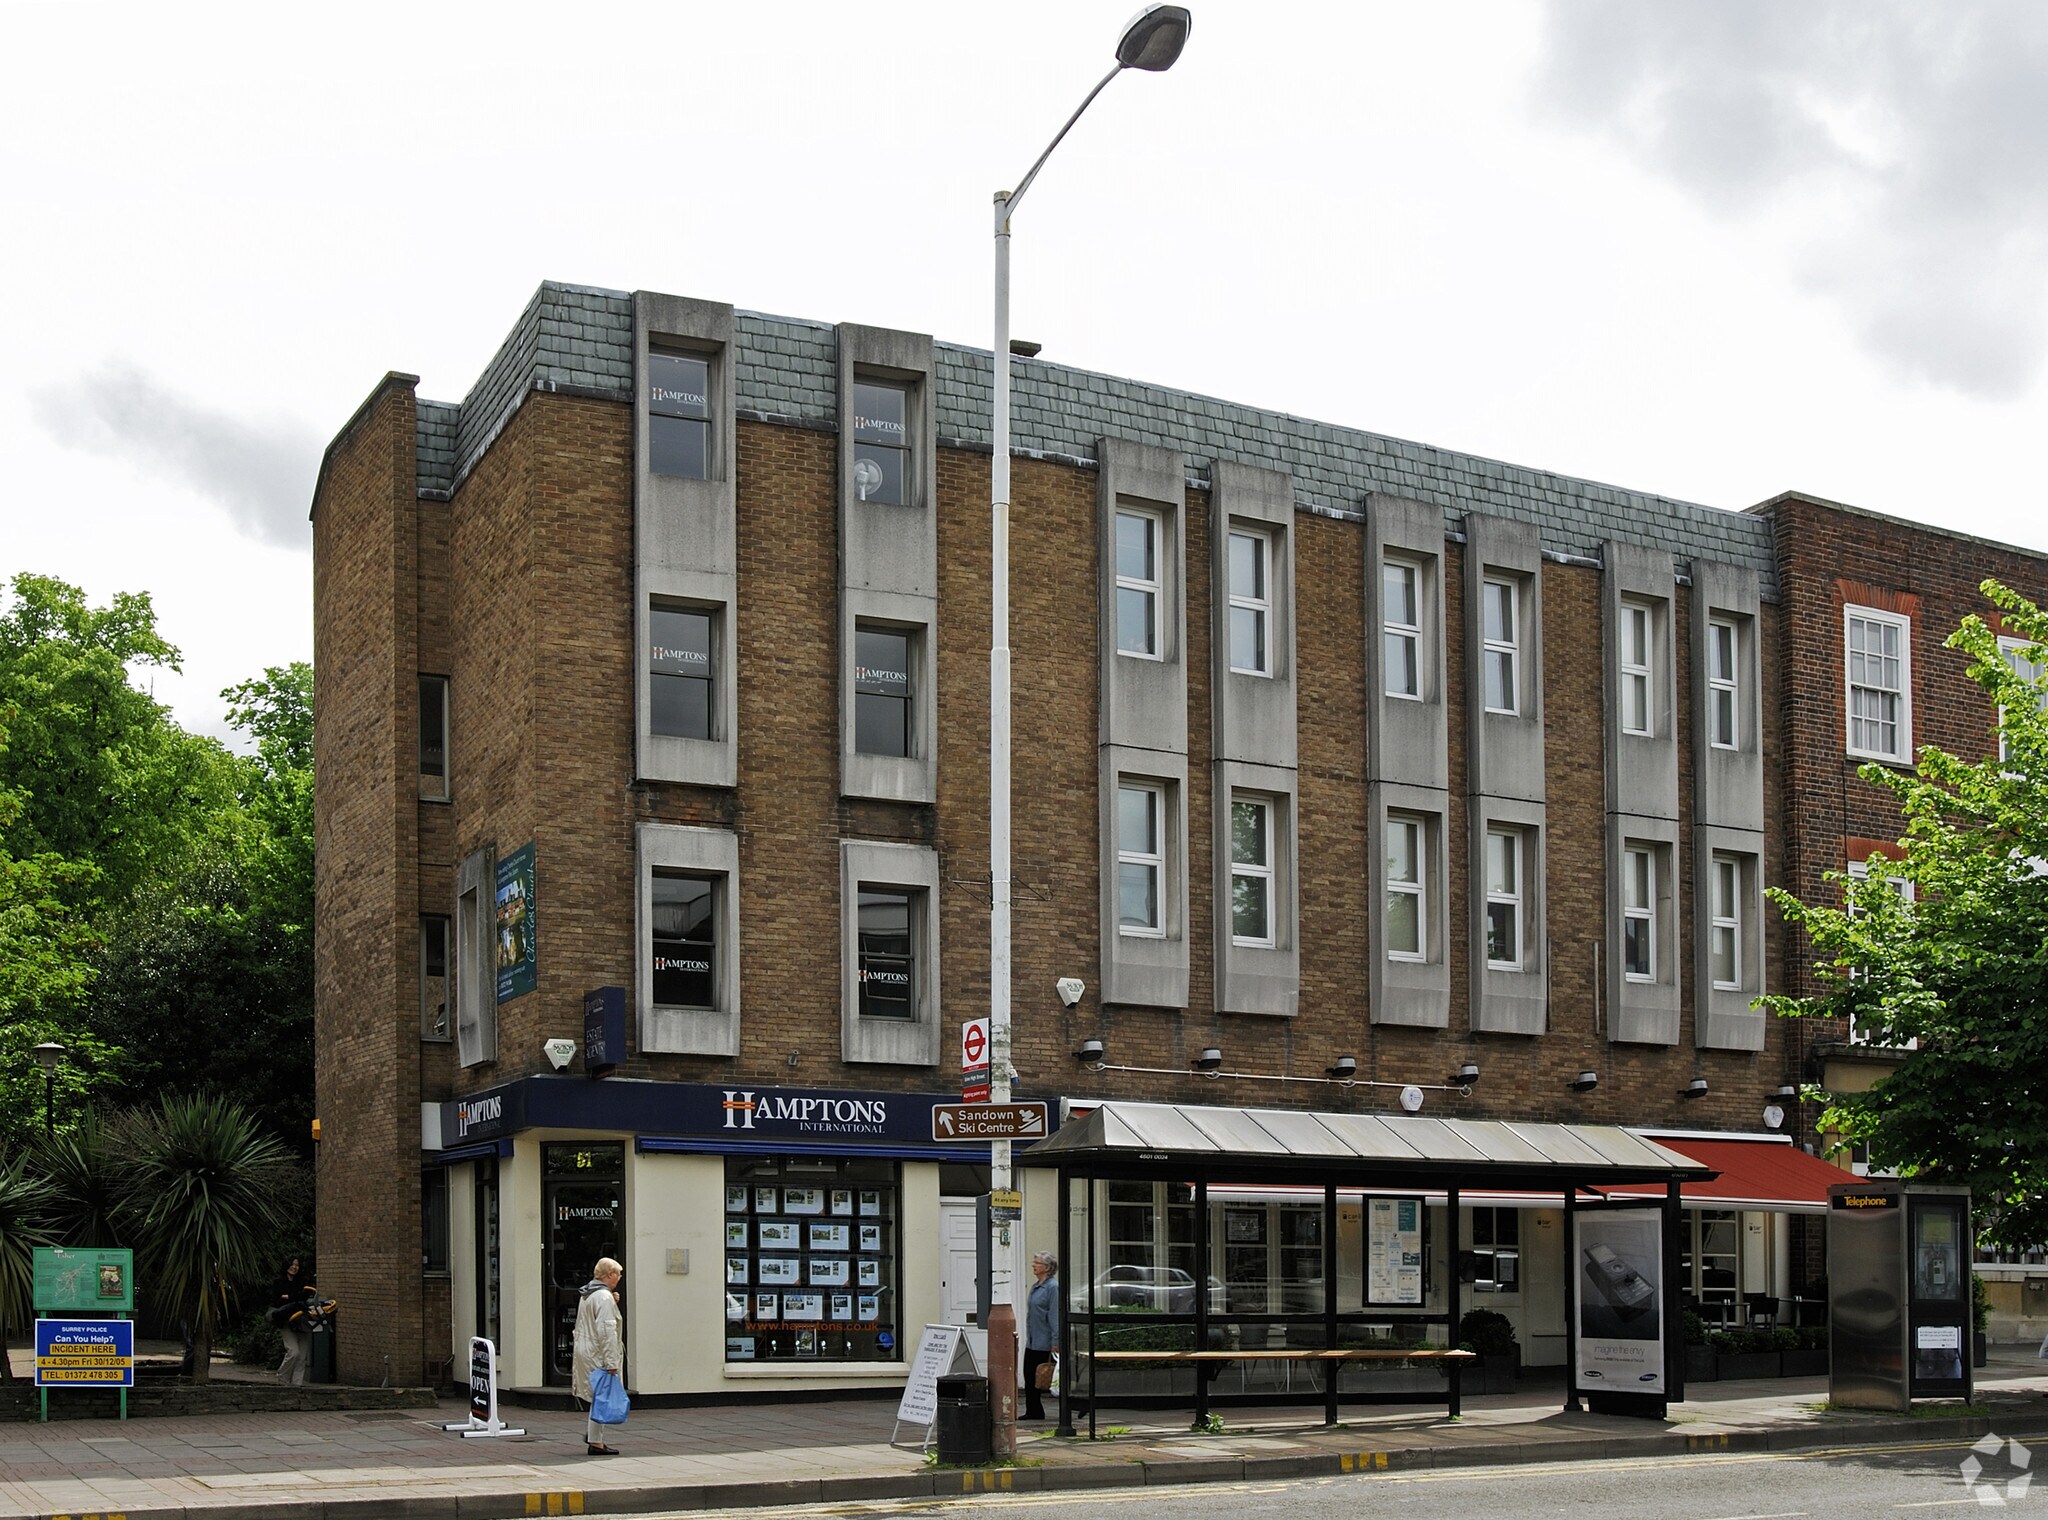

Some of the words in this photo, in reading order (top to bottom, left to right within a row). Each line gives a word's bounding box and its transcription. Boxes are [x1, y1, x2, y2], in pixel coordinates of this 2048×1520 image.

[652, 387, 706, 404] HAMPTONS
[855, 416, 906, 431] HAMPTONS
[653, 646, 707, 661] HAMPTONS
[856, 667, 907, 681] HAMPTONS
[655, 957, 709, 971] HAMPTONS
[858, 969, 909, 982] HAMPTONS
[458, 1095, 502, 1137] HAMPTONS
[722, 1091, 887, 1129] HAMPTONS
[959, 1110, 1014, 1120] Sandown
[800, 1122, 885, 1133] INTERNATIONAL
[959, 1123, 975, 1133] Ski
[978, 1122, 1014, 1133] Centre
[576, 1151, 592, 1168] 51
[1844, 1196, 1887, 1208] Telephone
[558, 1206, 614, 1221] HAMPTONS
[745, 1321, 879, 1333] www.hamptons.co.uk
[55, 1335, 71, 1343] Can
[73, 1335, 89, 1343] You
[90, 1335, 114, 1344] Help?
[51, 1345, 90, 1353] INCIDENT
[91, 1345, 114, 1353] HERE
[52, 1358, 80, 1367] 4.30pm
[81, 1358, 92, 1366] Fri
[94, 1358, 125, 1366] 30/12/05
[45, 1371, 63, 1379] TEL:
[65, 1371, 89, 1379] 01372
[89, 1371, 103, 1379] 478
[104, 1371, 118, 1379] 305
[471, 1375, 490, 1393] OPEN
